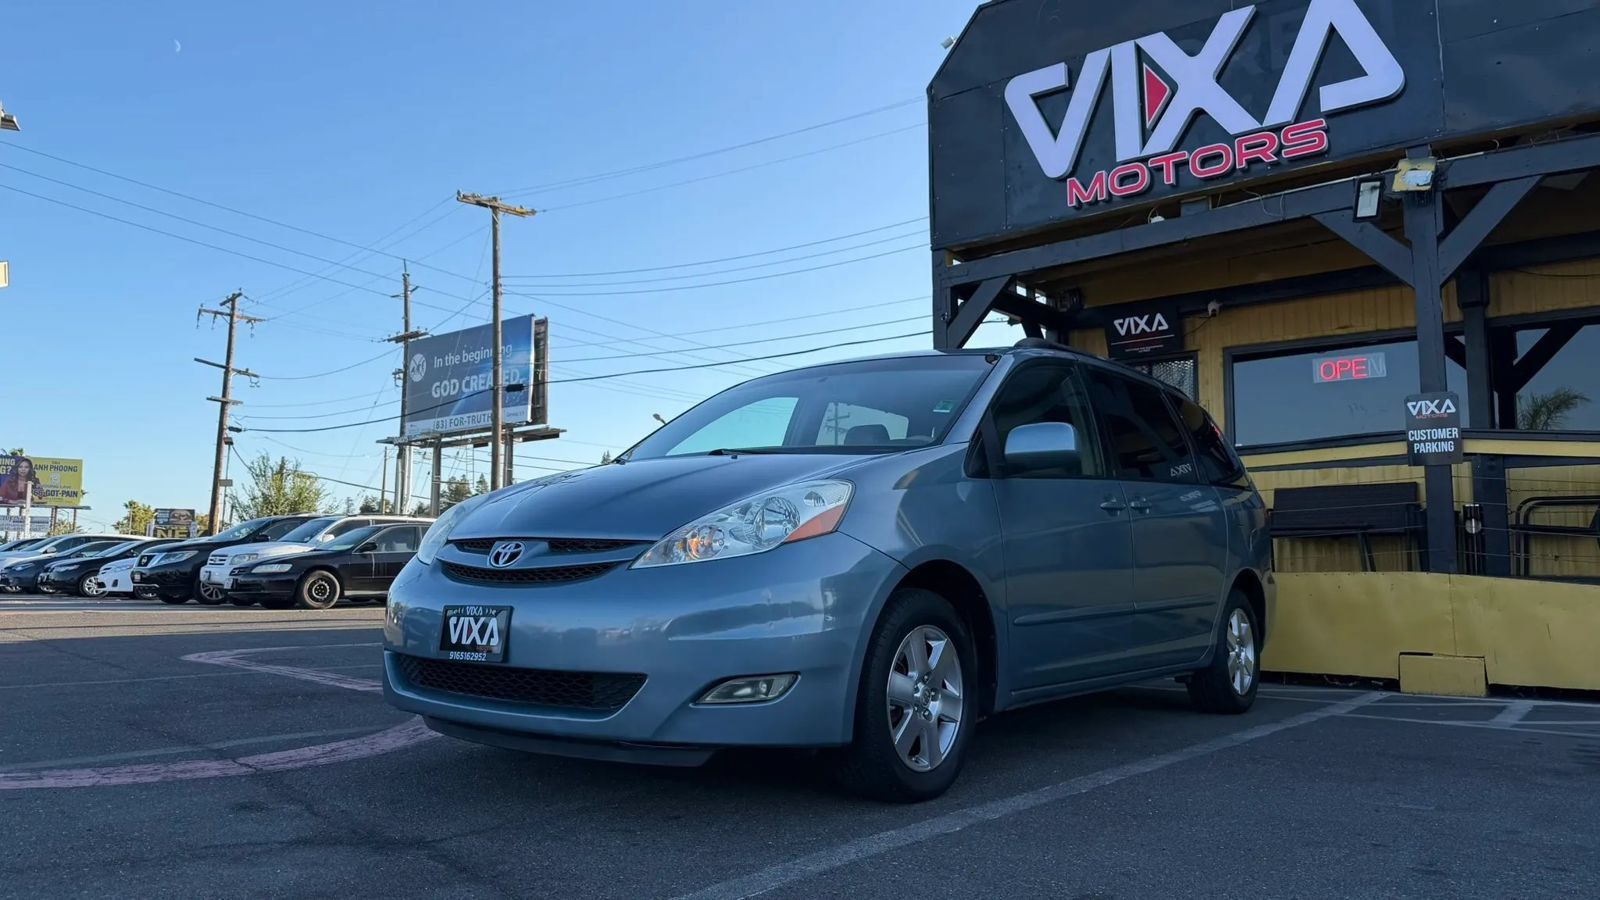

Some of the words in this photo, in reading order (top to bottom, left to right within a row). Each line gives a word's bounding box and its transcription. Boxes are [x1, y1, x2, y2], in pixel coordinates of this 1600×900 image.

[1004, 0, 1406, 179] VIXA
[1066, 118, 1329, 207] MOTORS
[1113, 312, 1169, 336] VIXA
[434, 356, 443, 369] In
[445, 353, 460, 366] the
[462, 344, 513, 363] beginng
[1320, 354, 1386, 382] OPEN
[432, 378, 460, 398] GOD
[1406, 398, 1456, 417] VIXA
[1408, 427, 1459, 442] CUSTOMER
[1413, 440, 1455, 454] PARKING
[449, 616, 499, 646] VIXA
[449, 651, 487, 662] 9165162952
